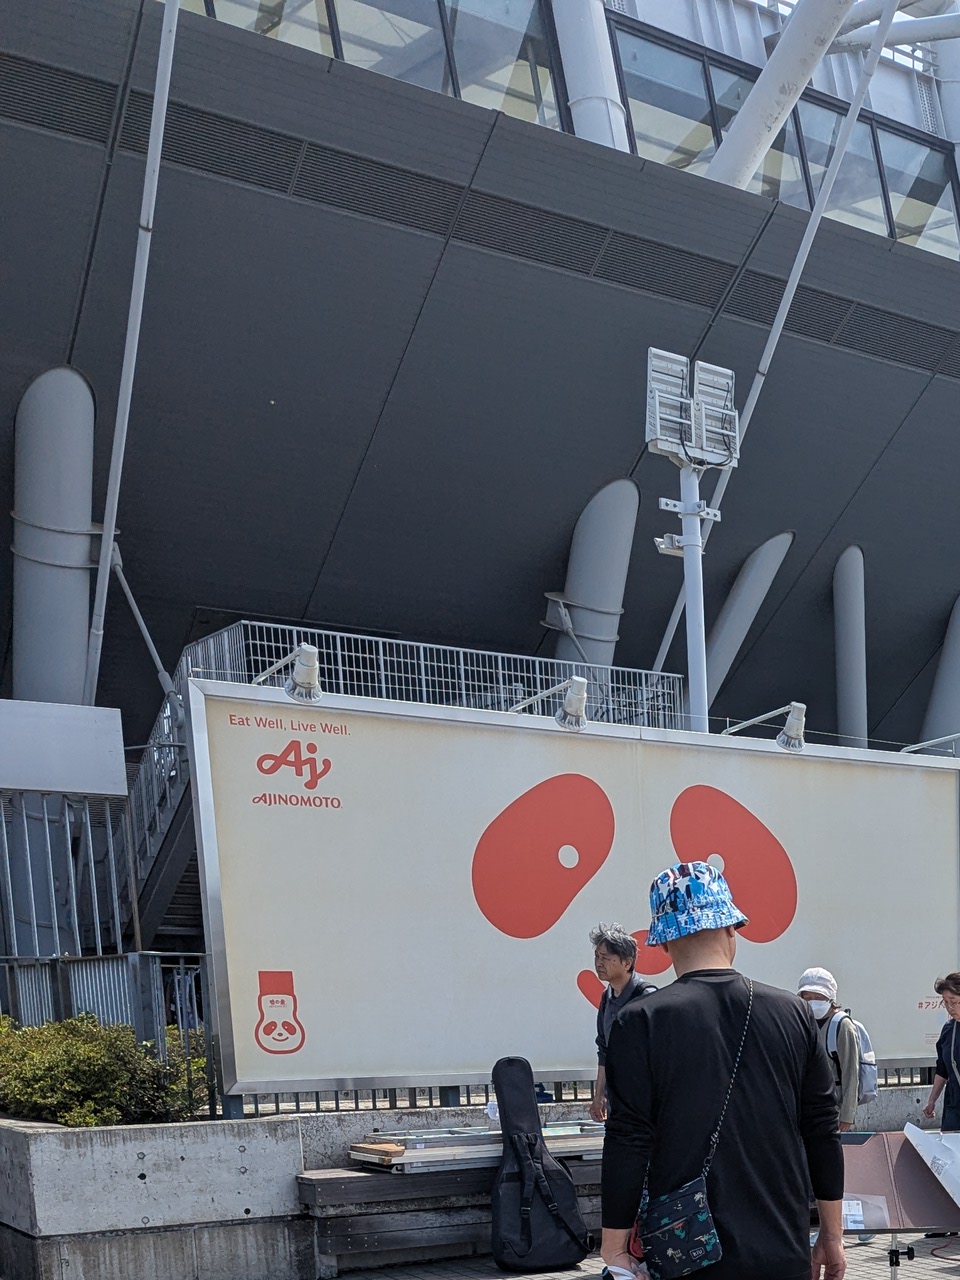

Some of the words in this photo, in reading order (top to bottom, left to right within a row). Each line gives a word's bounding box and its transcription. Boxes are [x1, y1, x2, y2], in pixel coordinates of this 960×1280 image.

[229, 714, 250, 727] Eat
[254, 716, 287, 731] Well,
[290, 720, 317, 732] Live
[320, 722, 351, 736] Well.
[252, 792, 341, 809] AJINOMOTO
